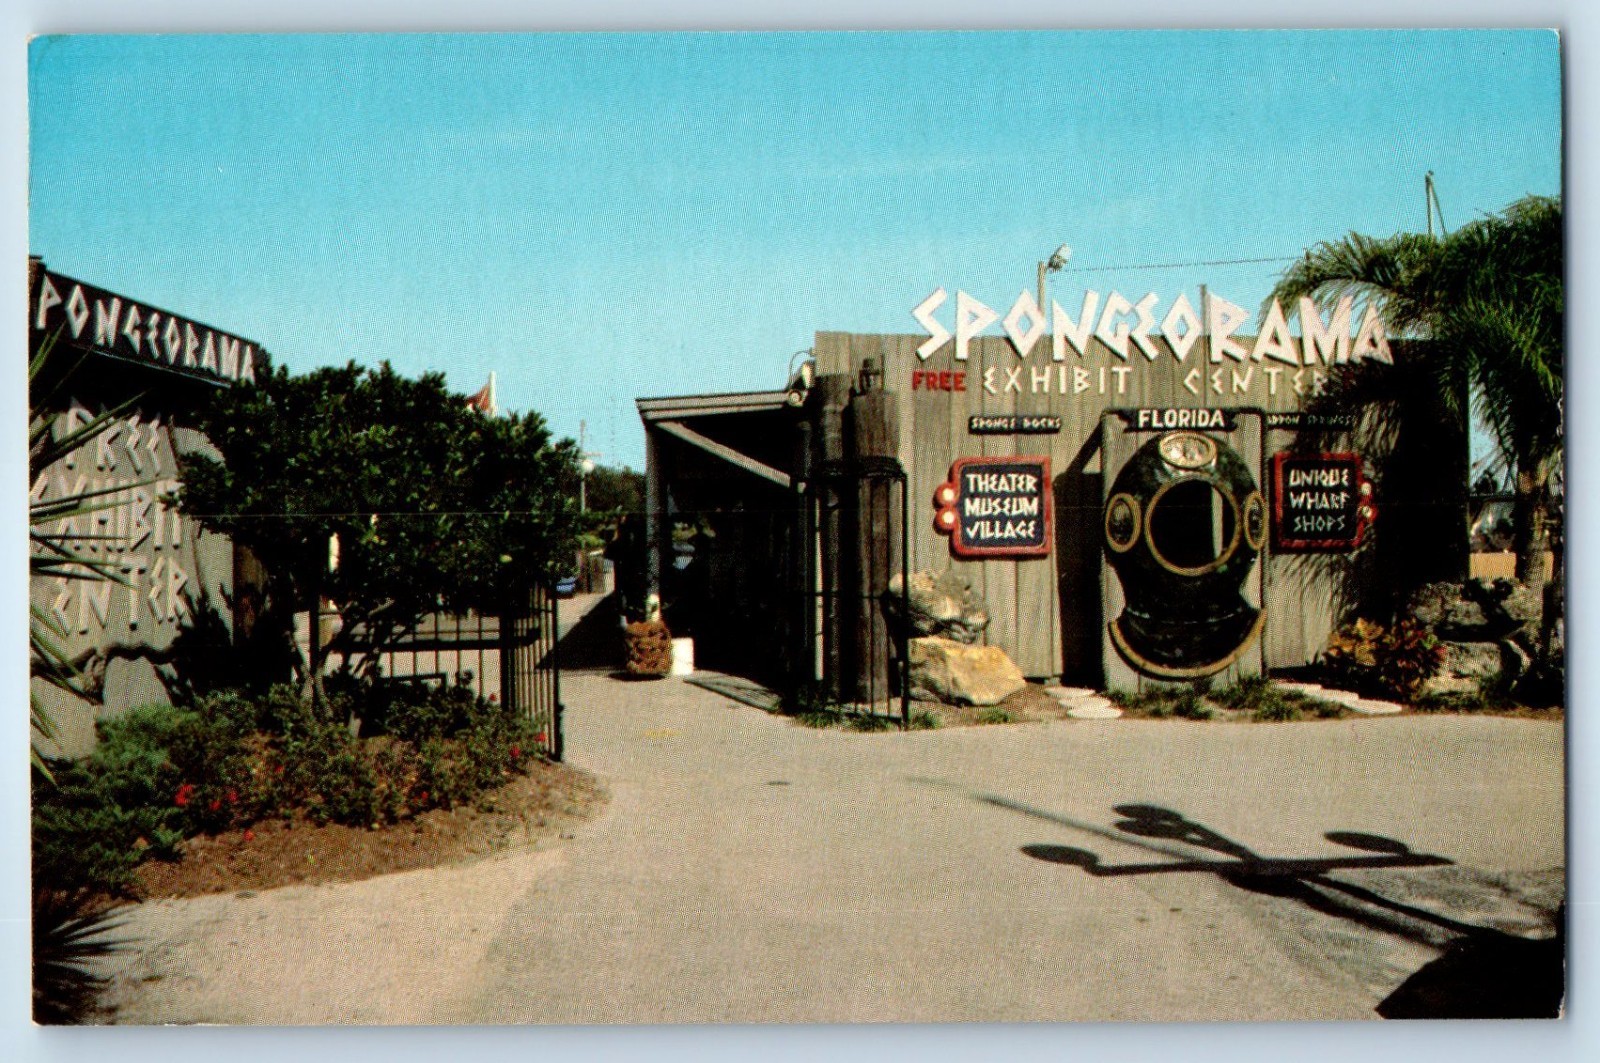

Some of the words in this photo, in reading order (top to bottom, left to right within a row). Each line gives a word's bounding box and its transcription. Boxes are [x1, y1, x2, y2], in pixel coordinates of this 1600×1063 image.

[36, 274, 256, 385] PONGEORAMA
[911, 286, 1394, 366] SPONGEORAMA
[911, 370, 966, 392] FREE
[982, 366, 1132, 395] EXHIBIT
[1183, 365, 1330, 396] CENTER
[1022, 416, 1061, 429] DOCKS
[1137, 409, 1225, 428] FLORIDA
[965, 472, 1038, 493] THEATER
[1289, 468, 1350, 487] UNIQUE
[964, 497, 1039, 517] MUSEUM
[1289, 490, 1350, 509] WHARF
[966, 520, 1036, 540] VILLAGE
[1293, 515, 1346, 533] SHOPS
